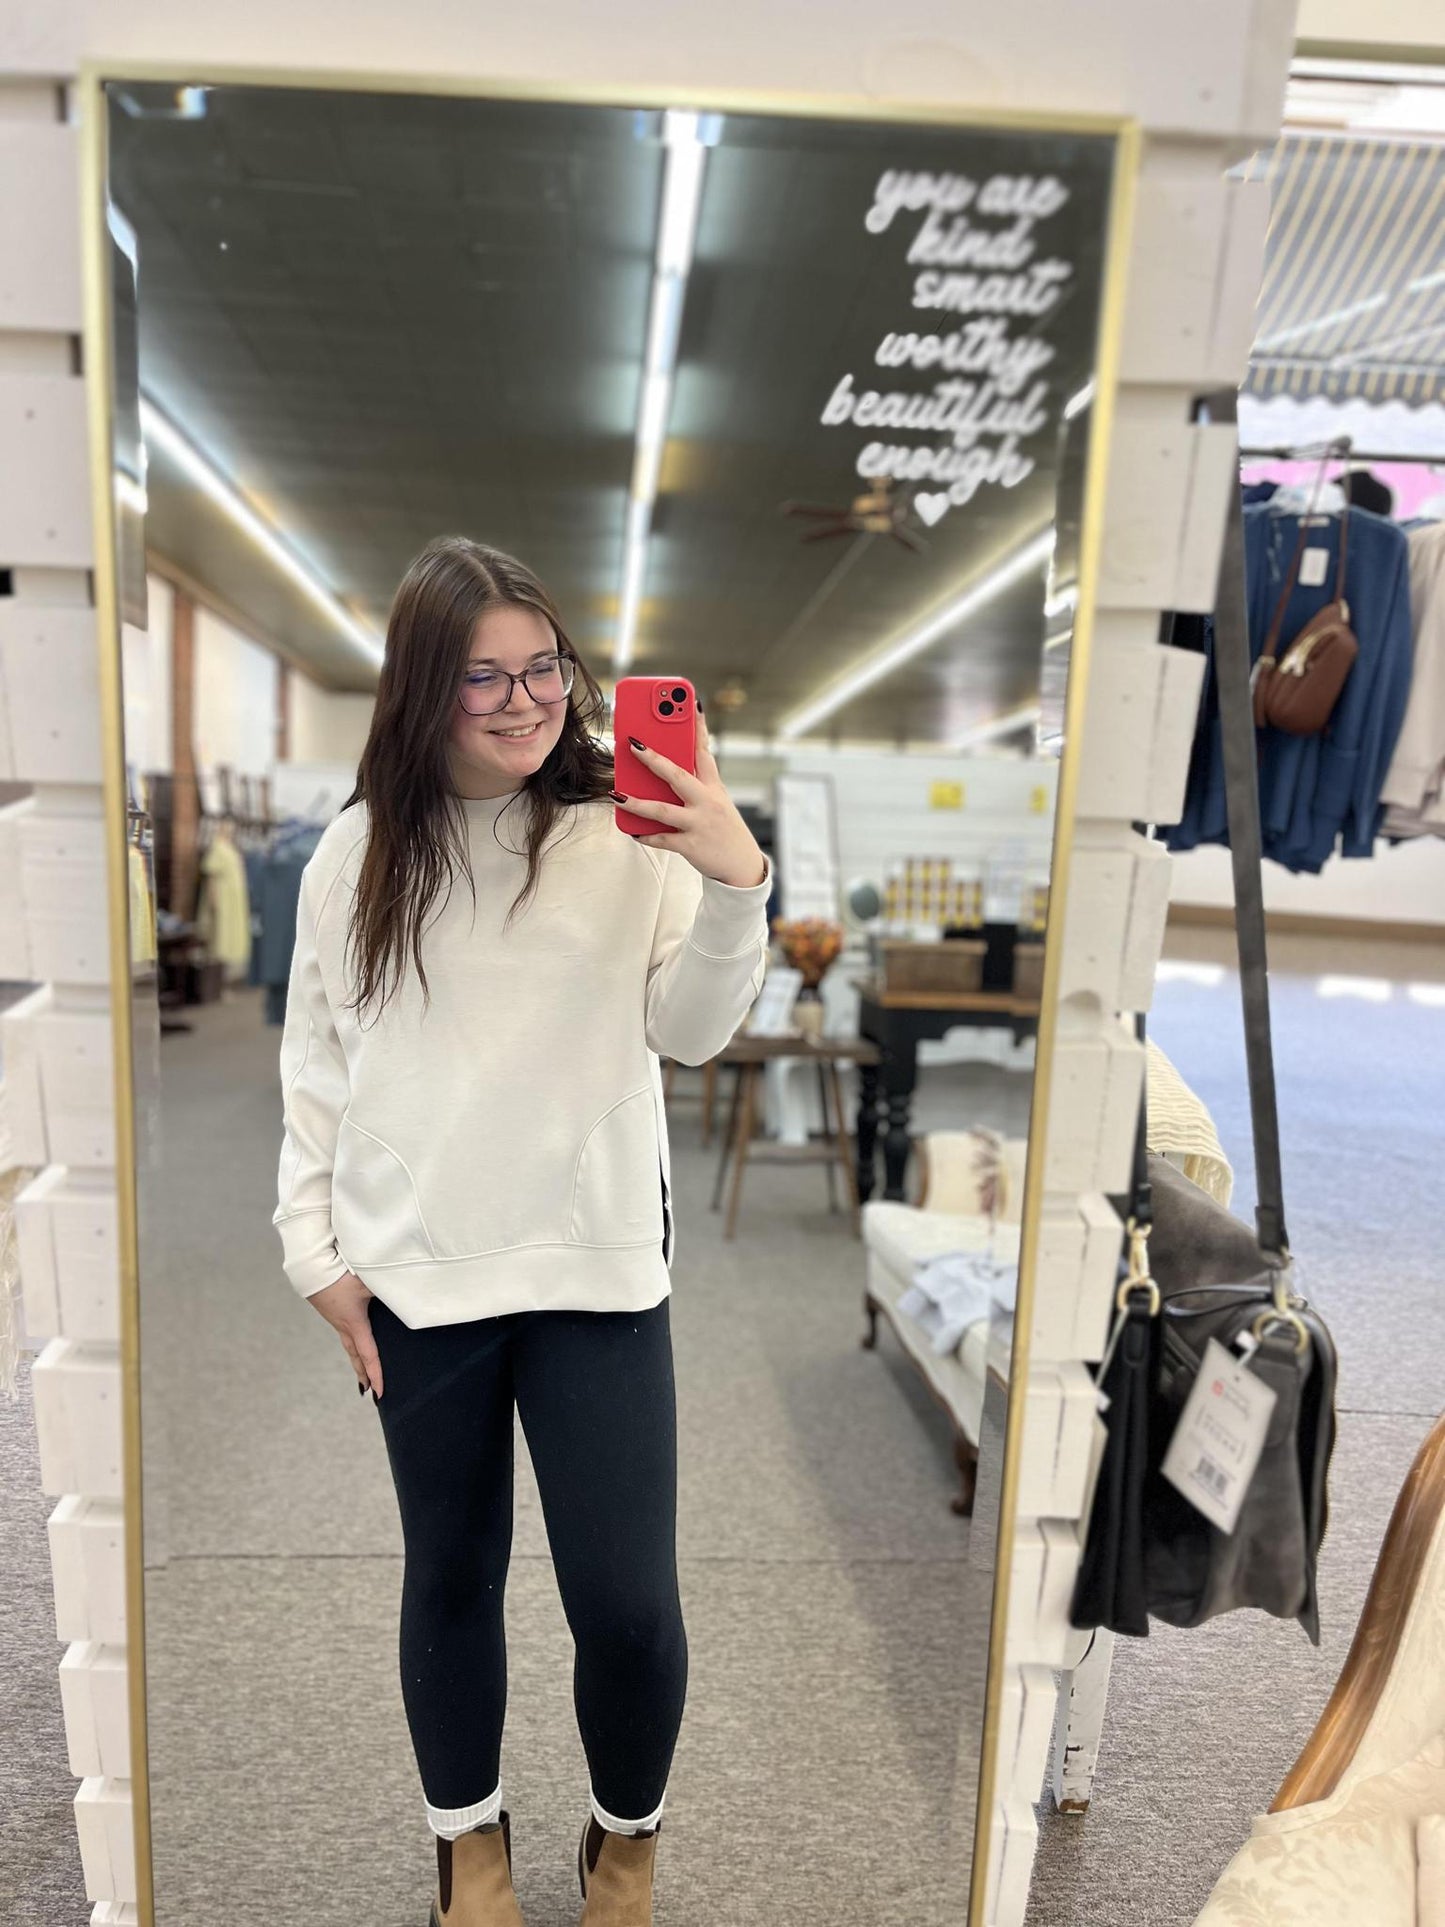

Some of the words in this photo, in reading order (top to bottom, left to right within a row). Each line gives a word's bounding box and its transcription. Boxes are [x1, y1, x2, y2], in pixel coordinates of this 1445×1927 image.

[906, 209, 1036, 268] kind
[912, 258, 1072, 314] smart
[875, 317, 1055, 396] worthy
[820, 373, 1047, 449] beautiful
[856, 437, 1036, 506] enough
